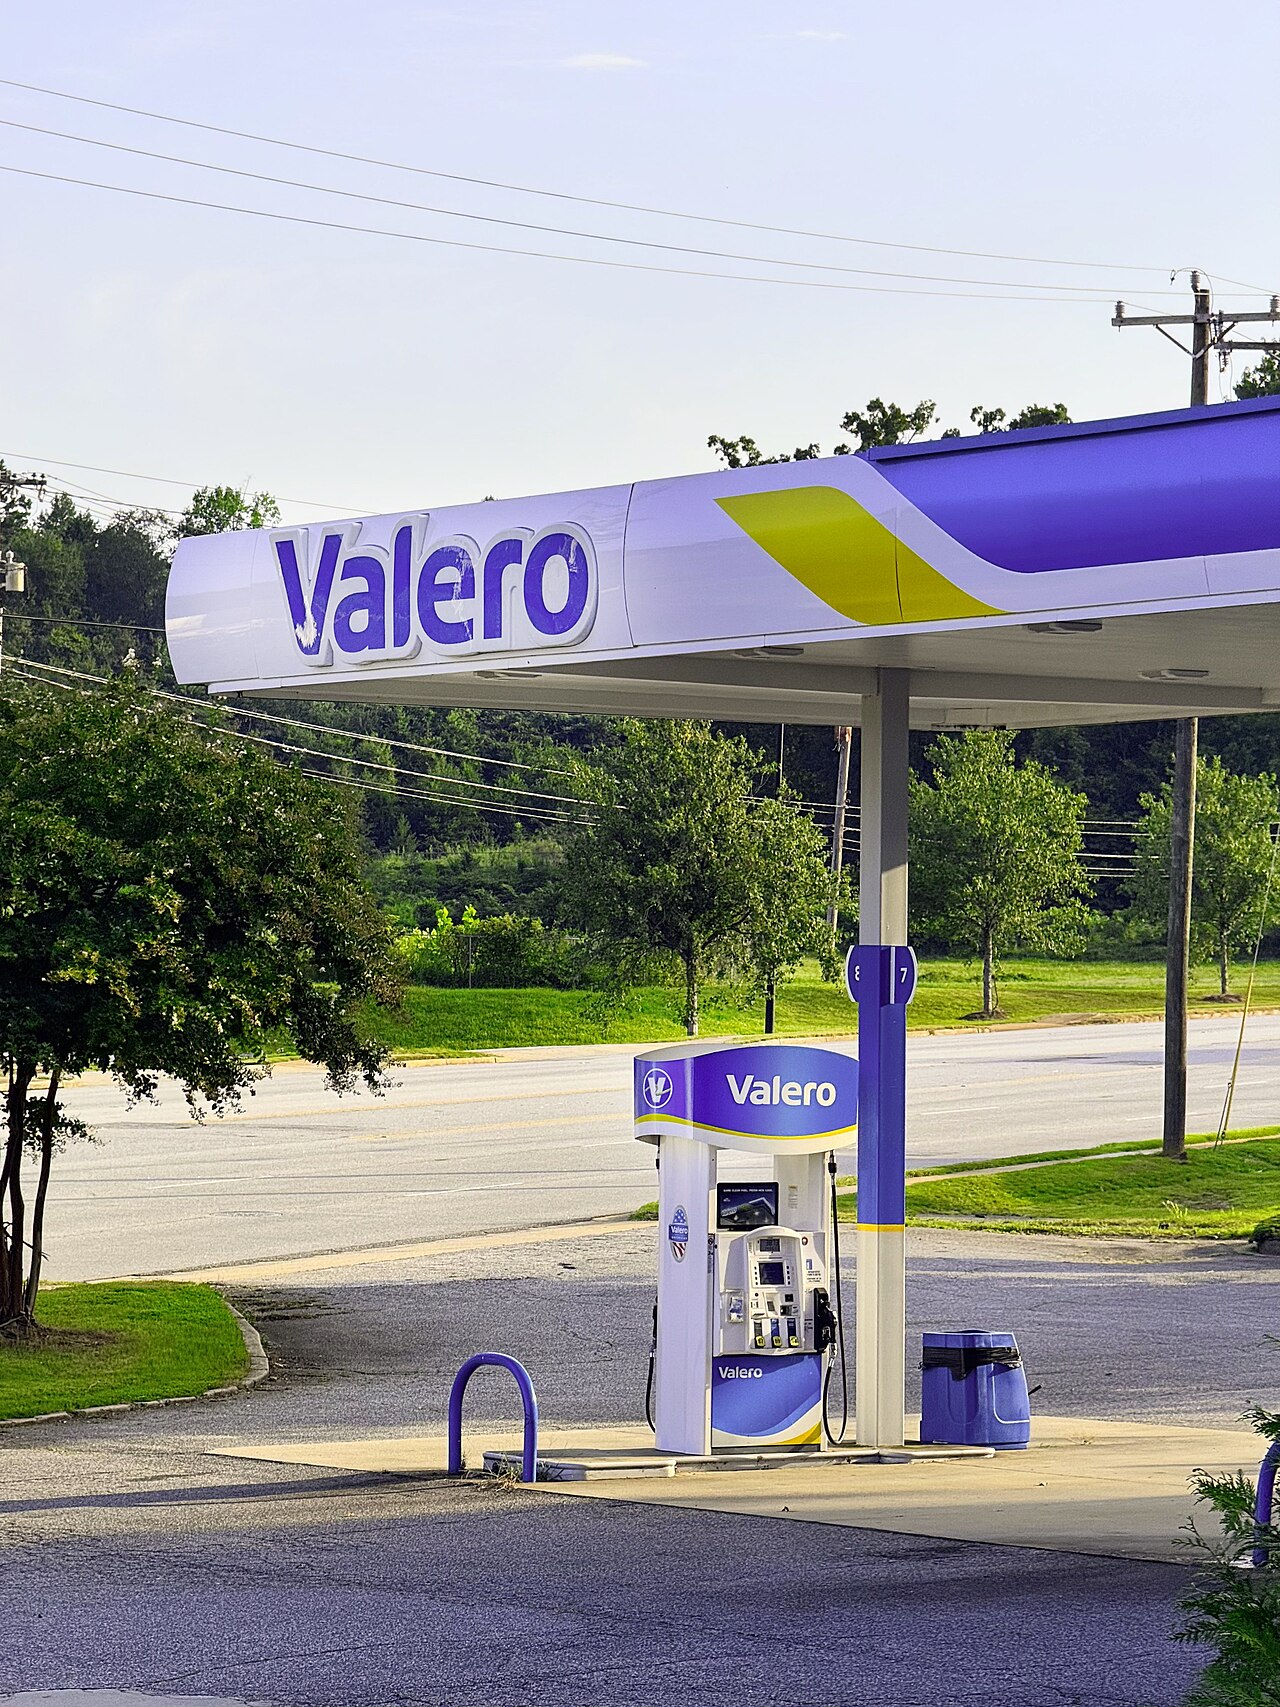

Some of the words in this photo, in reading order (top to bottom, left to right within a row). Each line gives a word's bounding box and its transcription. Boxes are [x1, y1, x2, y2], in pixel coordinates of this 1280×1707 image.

[275, 525, 588, 656] Valero
[854, 965, 860, 982] 8
[900, 967, 908, 984] 7
[726, 1074, 837, 1107] Valero
[670, 1225, 688, 1235] Valero
[718, 1366, 763, 1379] Valero
